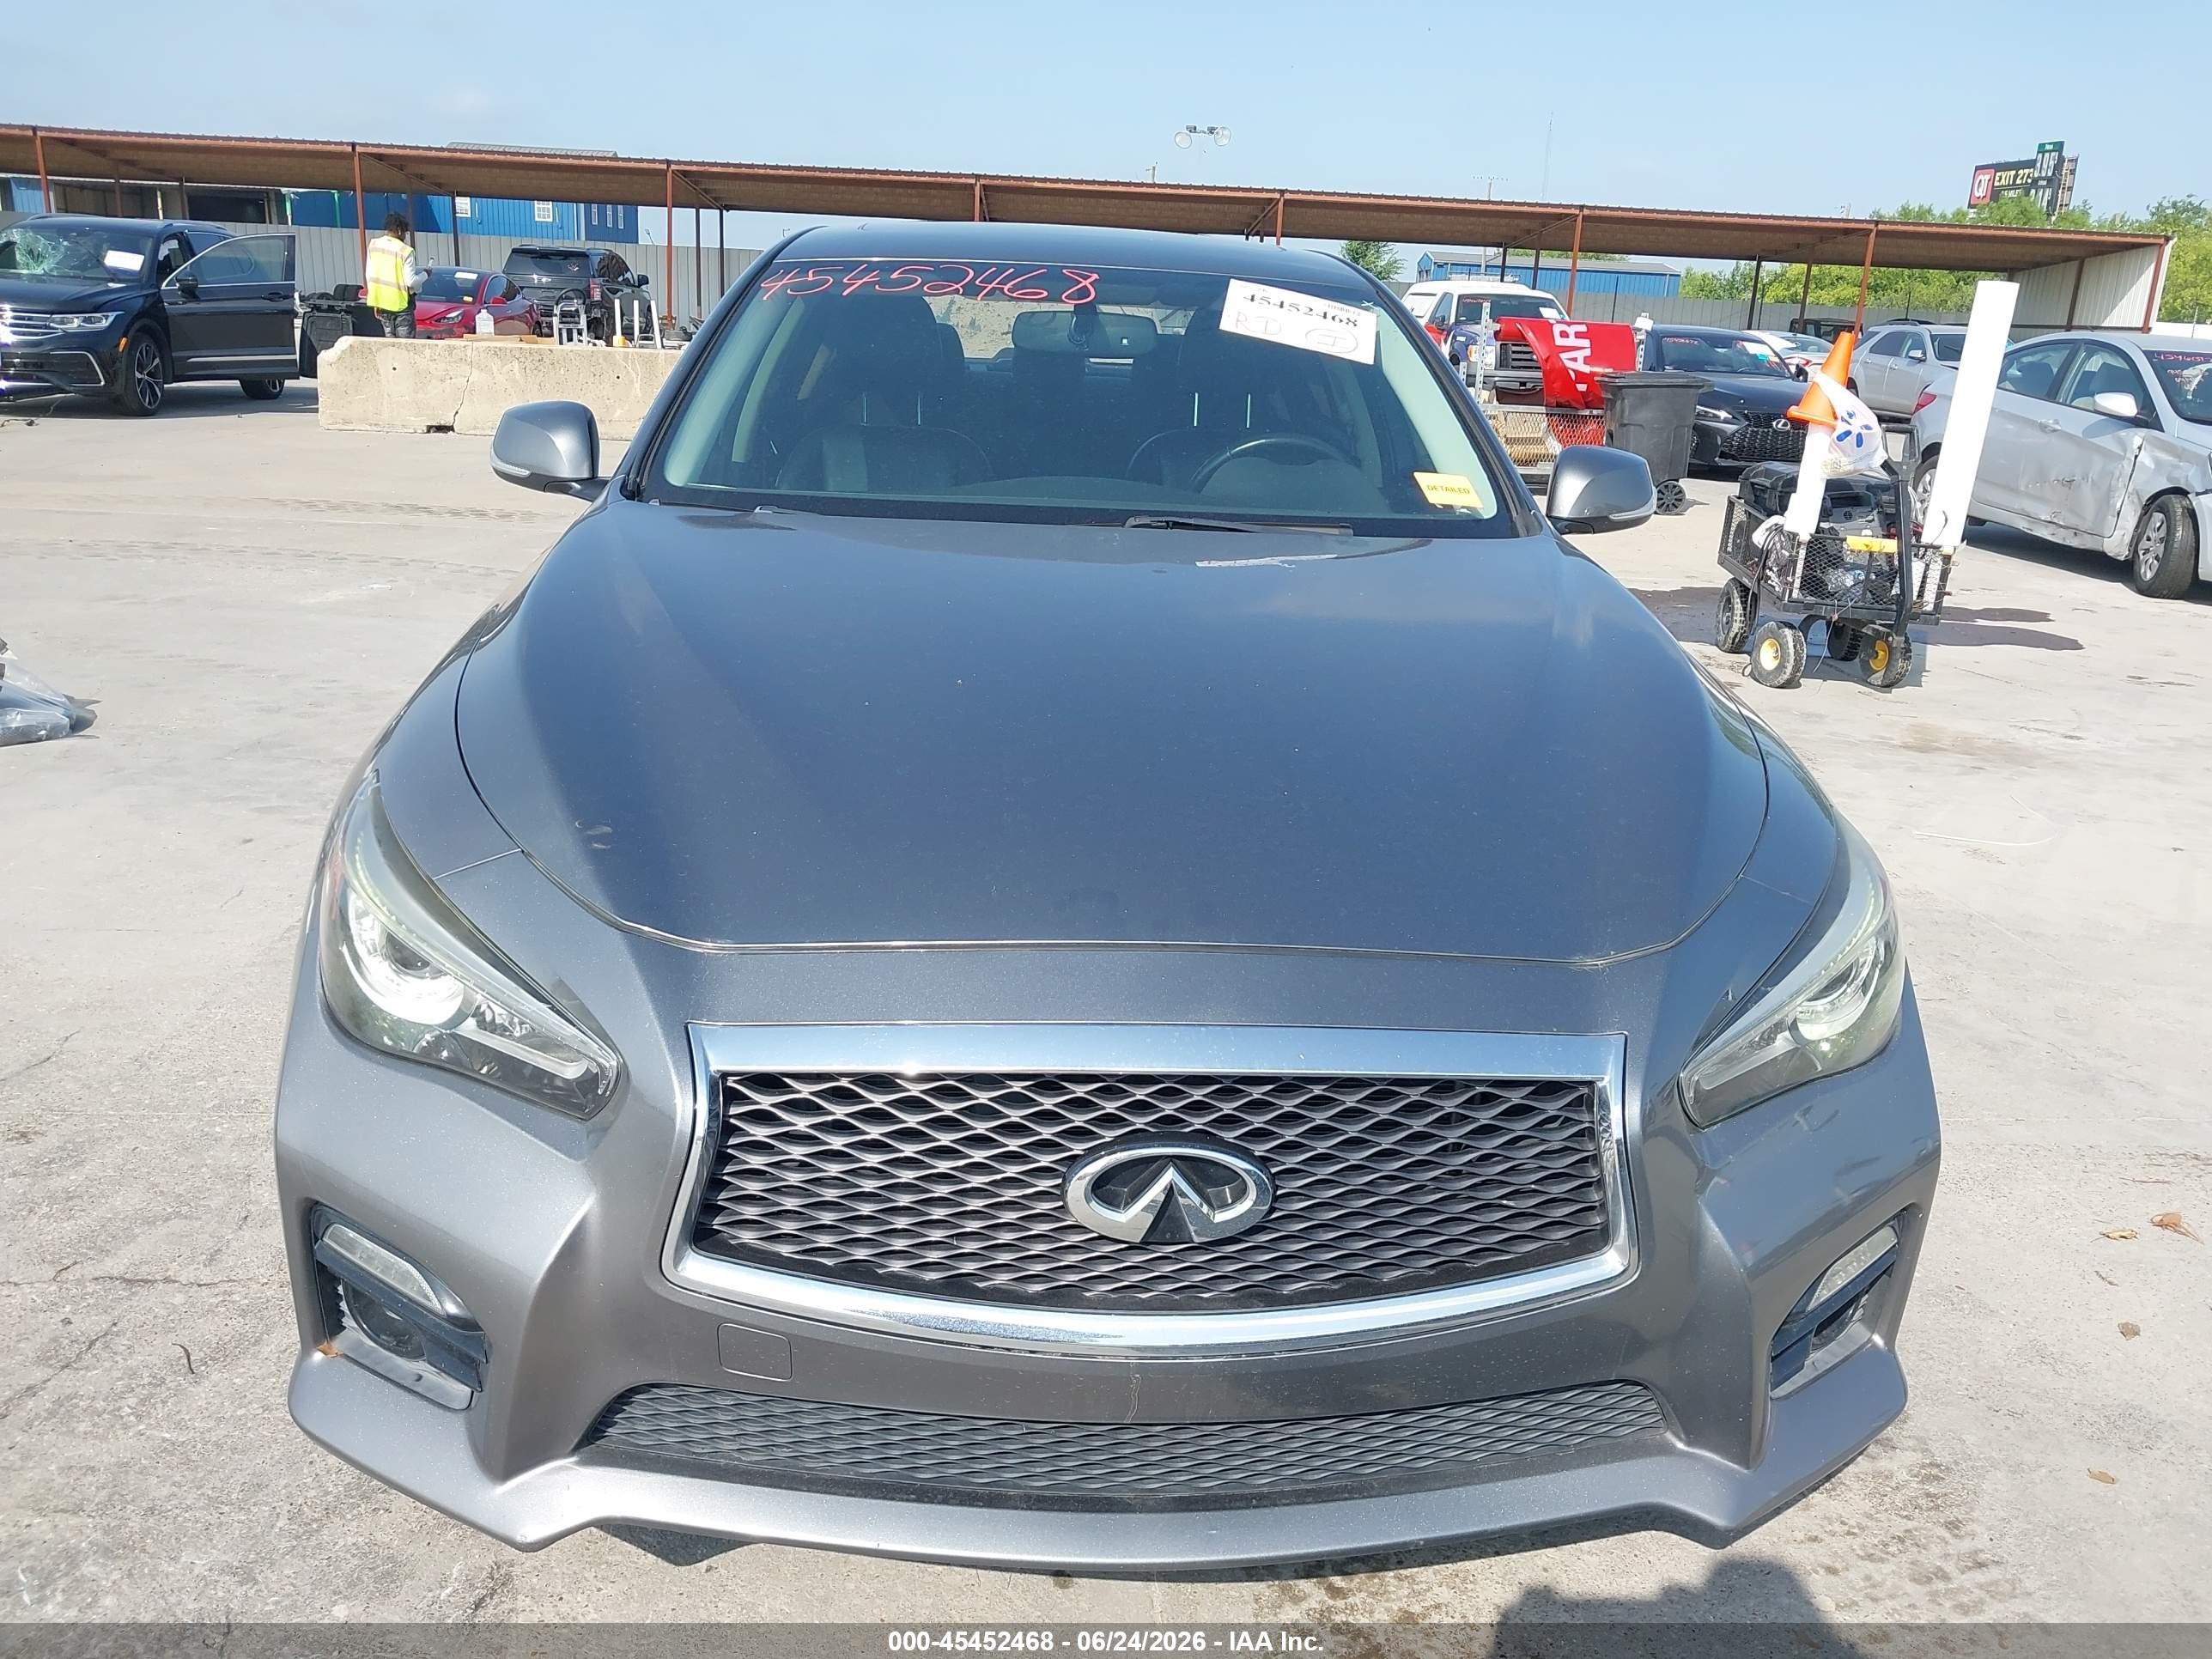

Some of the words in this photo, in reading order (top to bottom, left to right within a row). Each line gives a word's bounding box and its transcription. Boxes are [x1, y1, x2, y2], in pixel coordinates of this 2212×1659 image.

[1974, 174, 1990, 198] QT
[1994, 172, 2015, 185] EXIT
[2016, 168, 2033, 184] 273
[760, 264, 1100, 304] 45452468
[1243, 294, 1358, 327] 45452468
[1426, 484, 1470, 495] DETAILED
